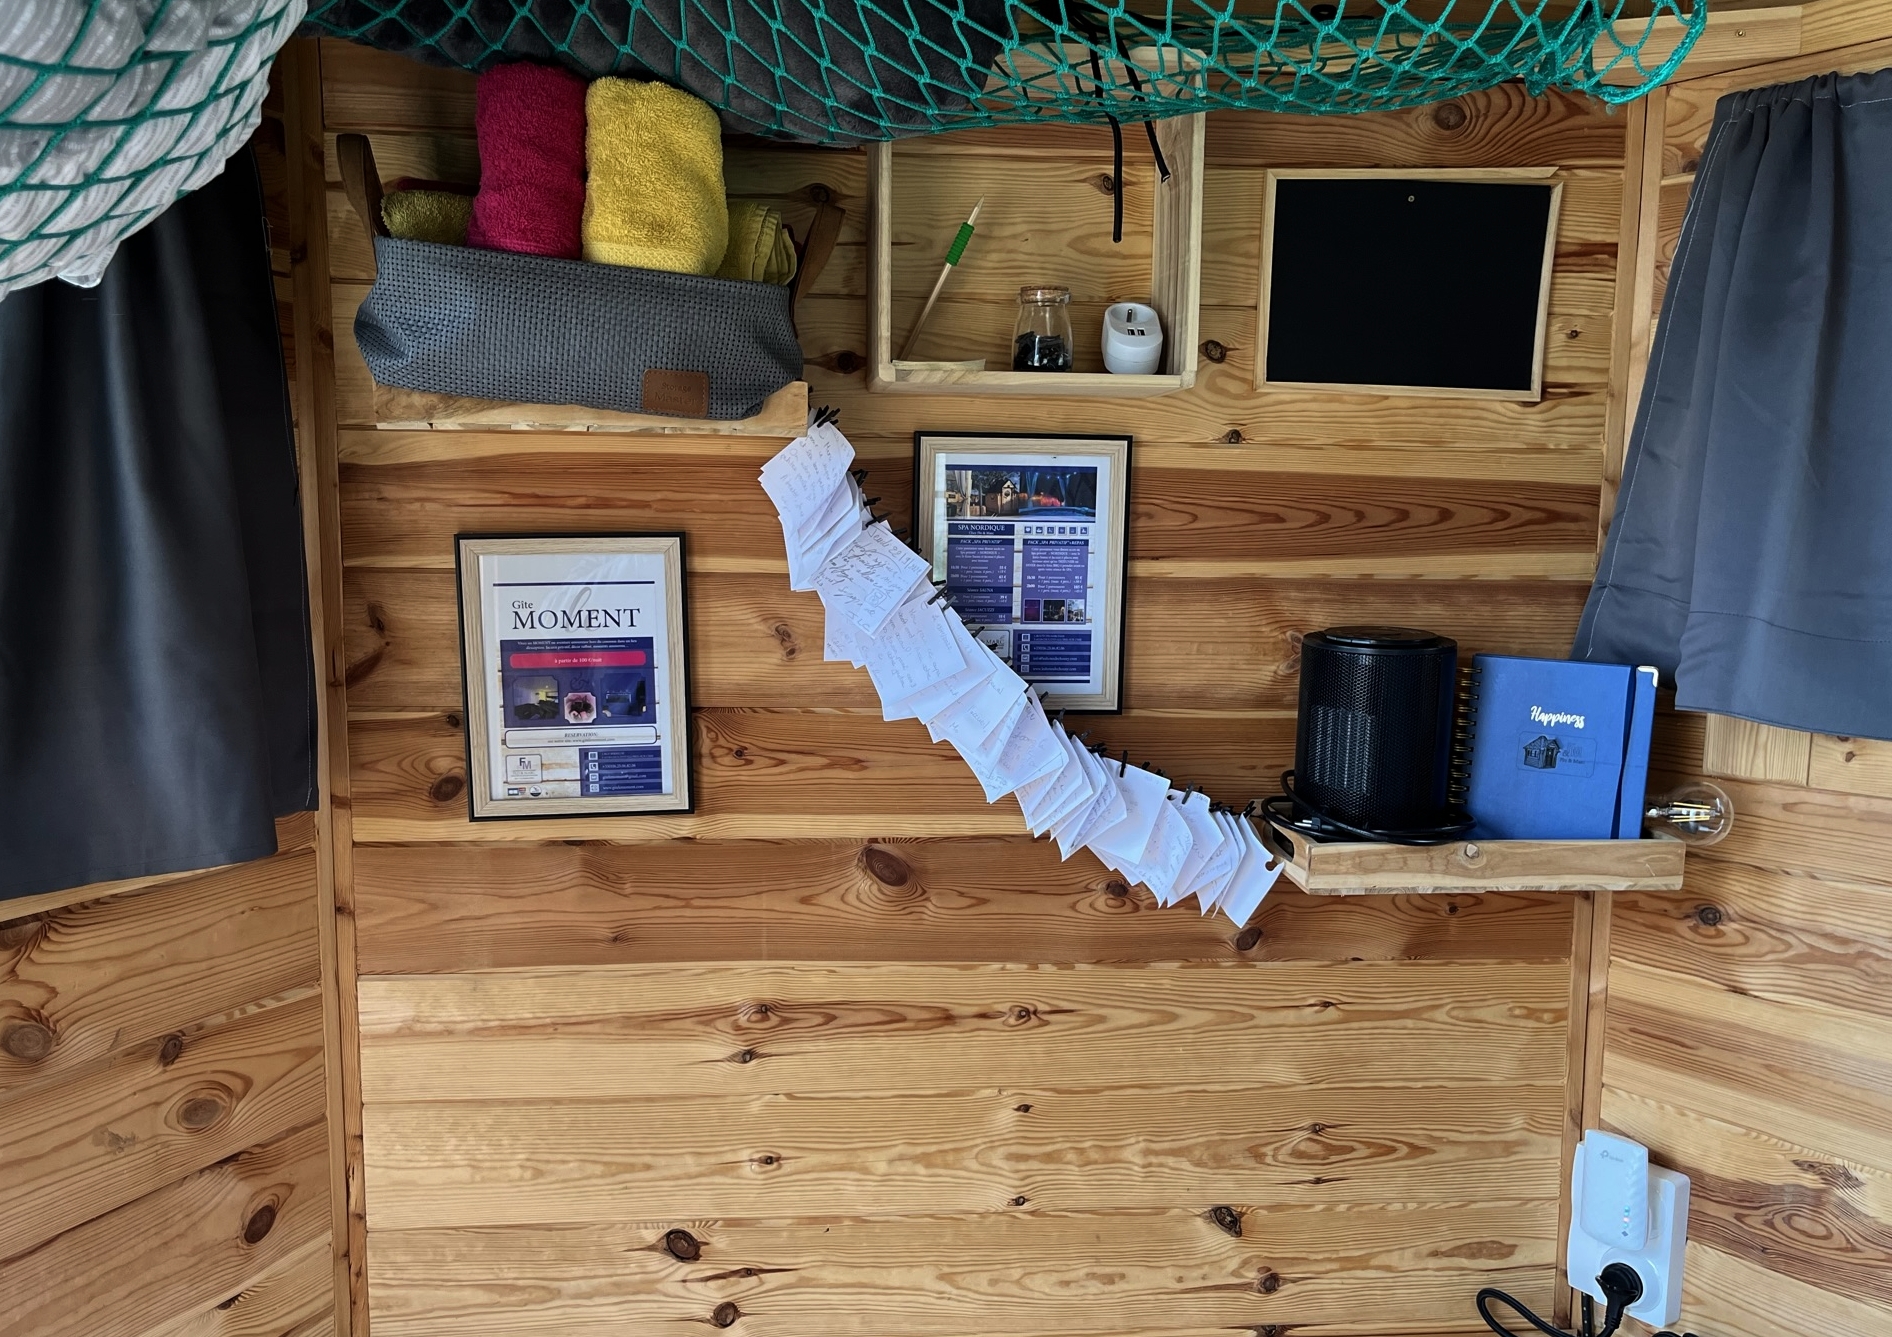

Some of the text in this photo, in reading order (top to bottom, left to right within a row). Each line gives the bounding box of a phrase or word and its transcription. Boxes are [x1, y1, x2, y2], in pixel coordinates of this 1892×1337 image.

[661, 382, 692, 393] Storage
[654, 391, 696, 405] Master
[970, 524, 1006, 532] NORDIQUE
[512, 608, 641, 630] MOMENT
[1530, 705, 1586, 729] Happiness
